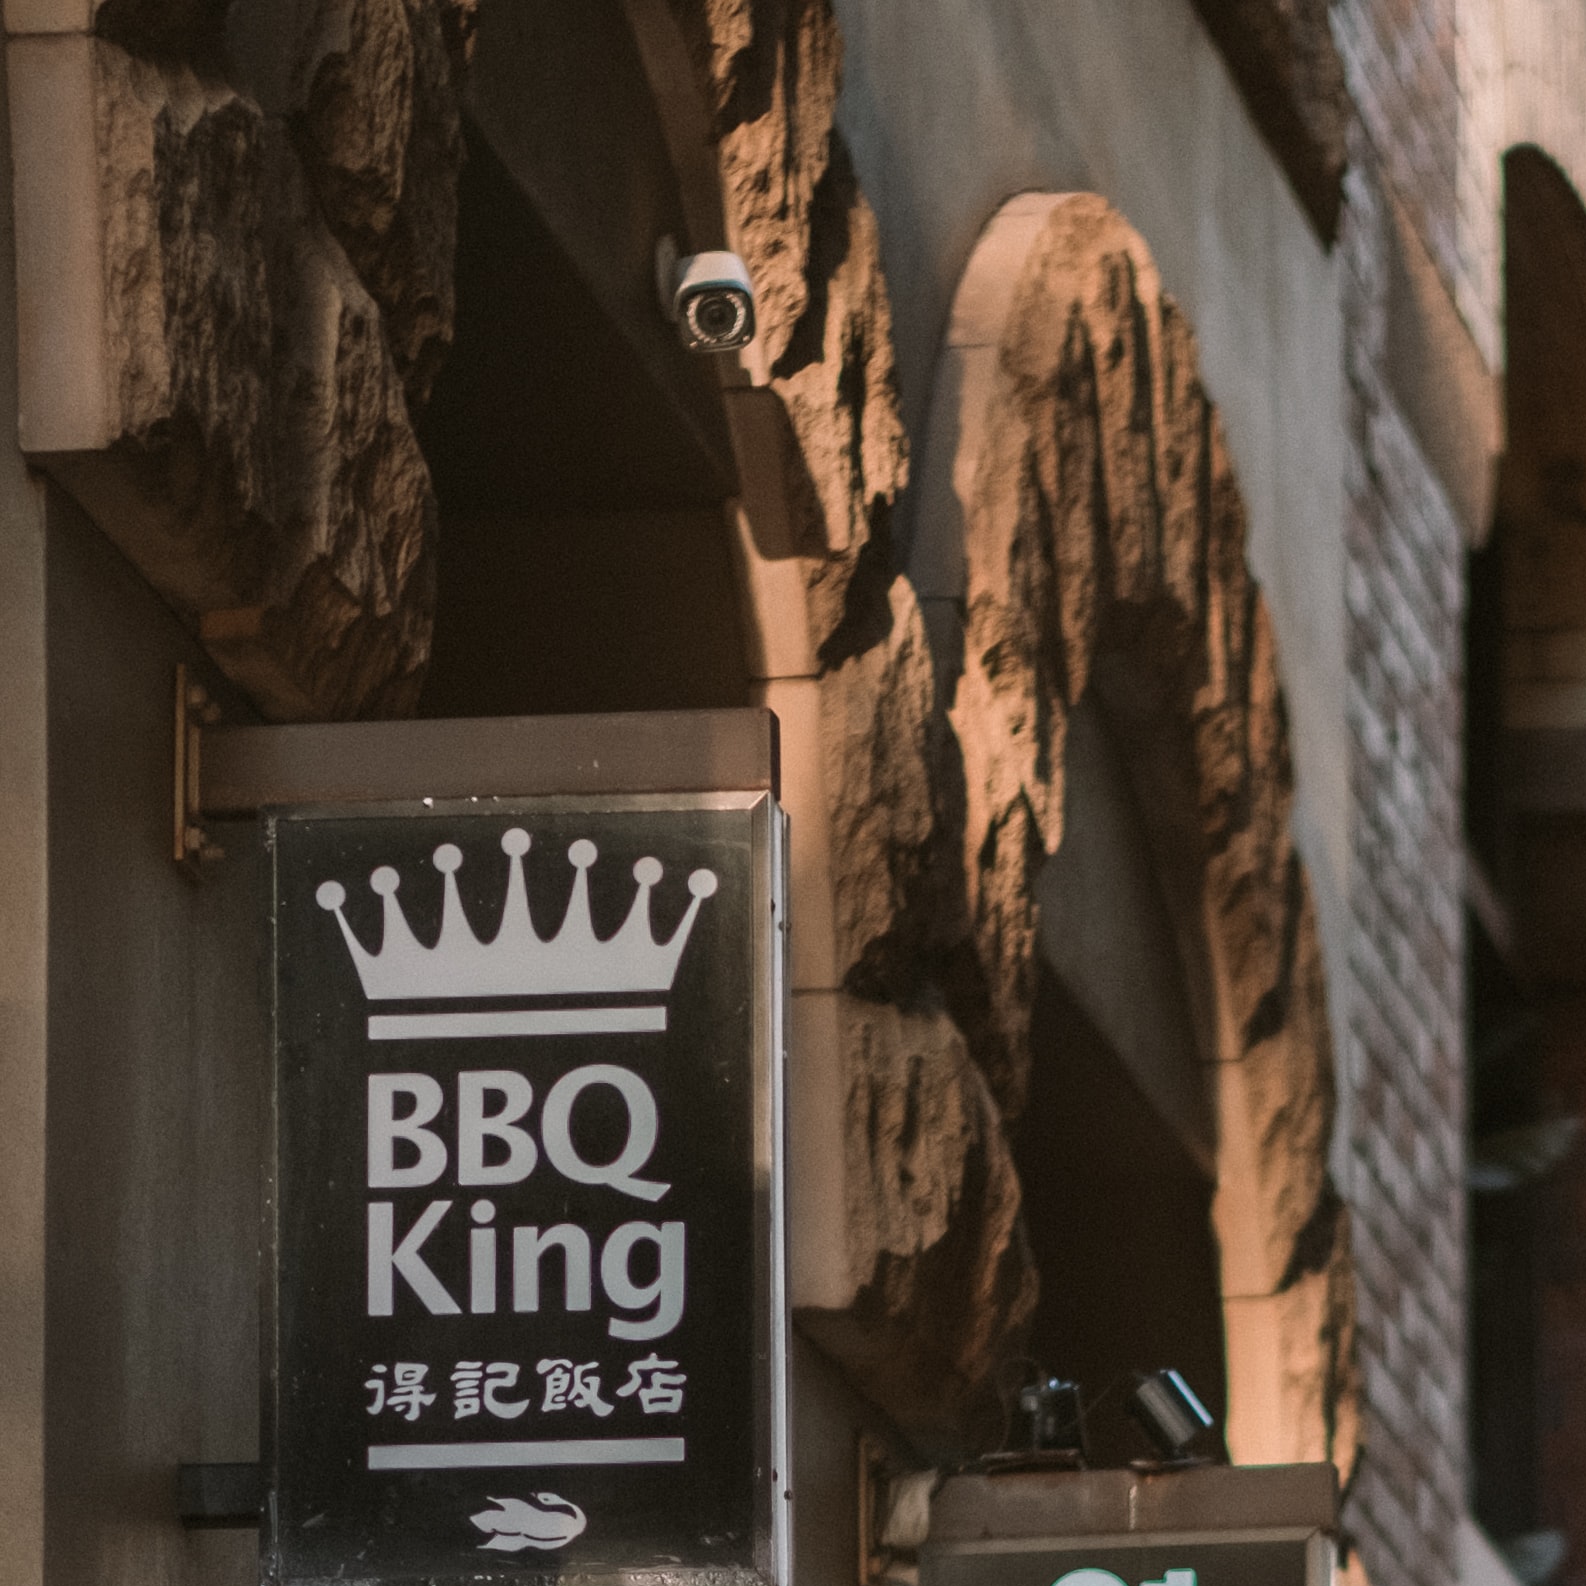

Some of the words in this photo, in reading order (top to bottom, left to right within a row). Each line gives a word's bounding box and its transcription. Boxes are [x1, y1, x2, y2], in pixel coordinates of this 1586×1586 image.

[367, 1063, 672, 1203] BBQ
[367, 1199, 686, 1341] King
[364, 1352, 687, 1422] 得記飯店
